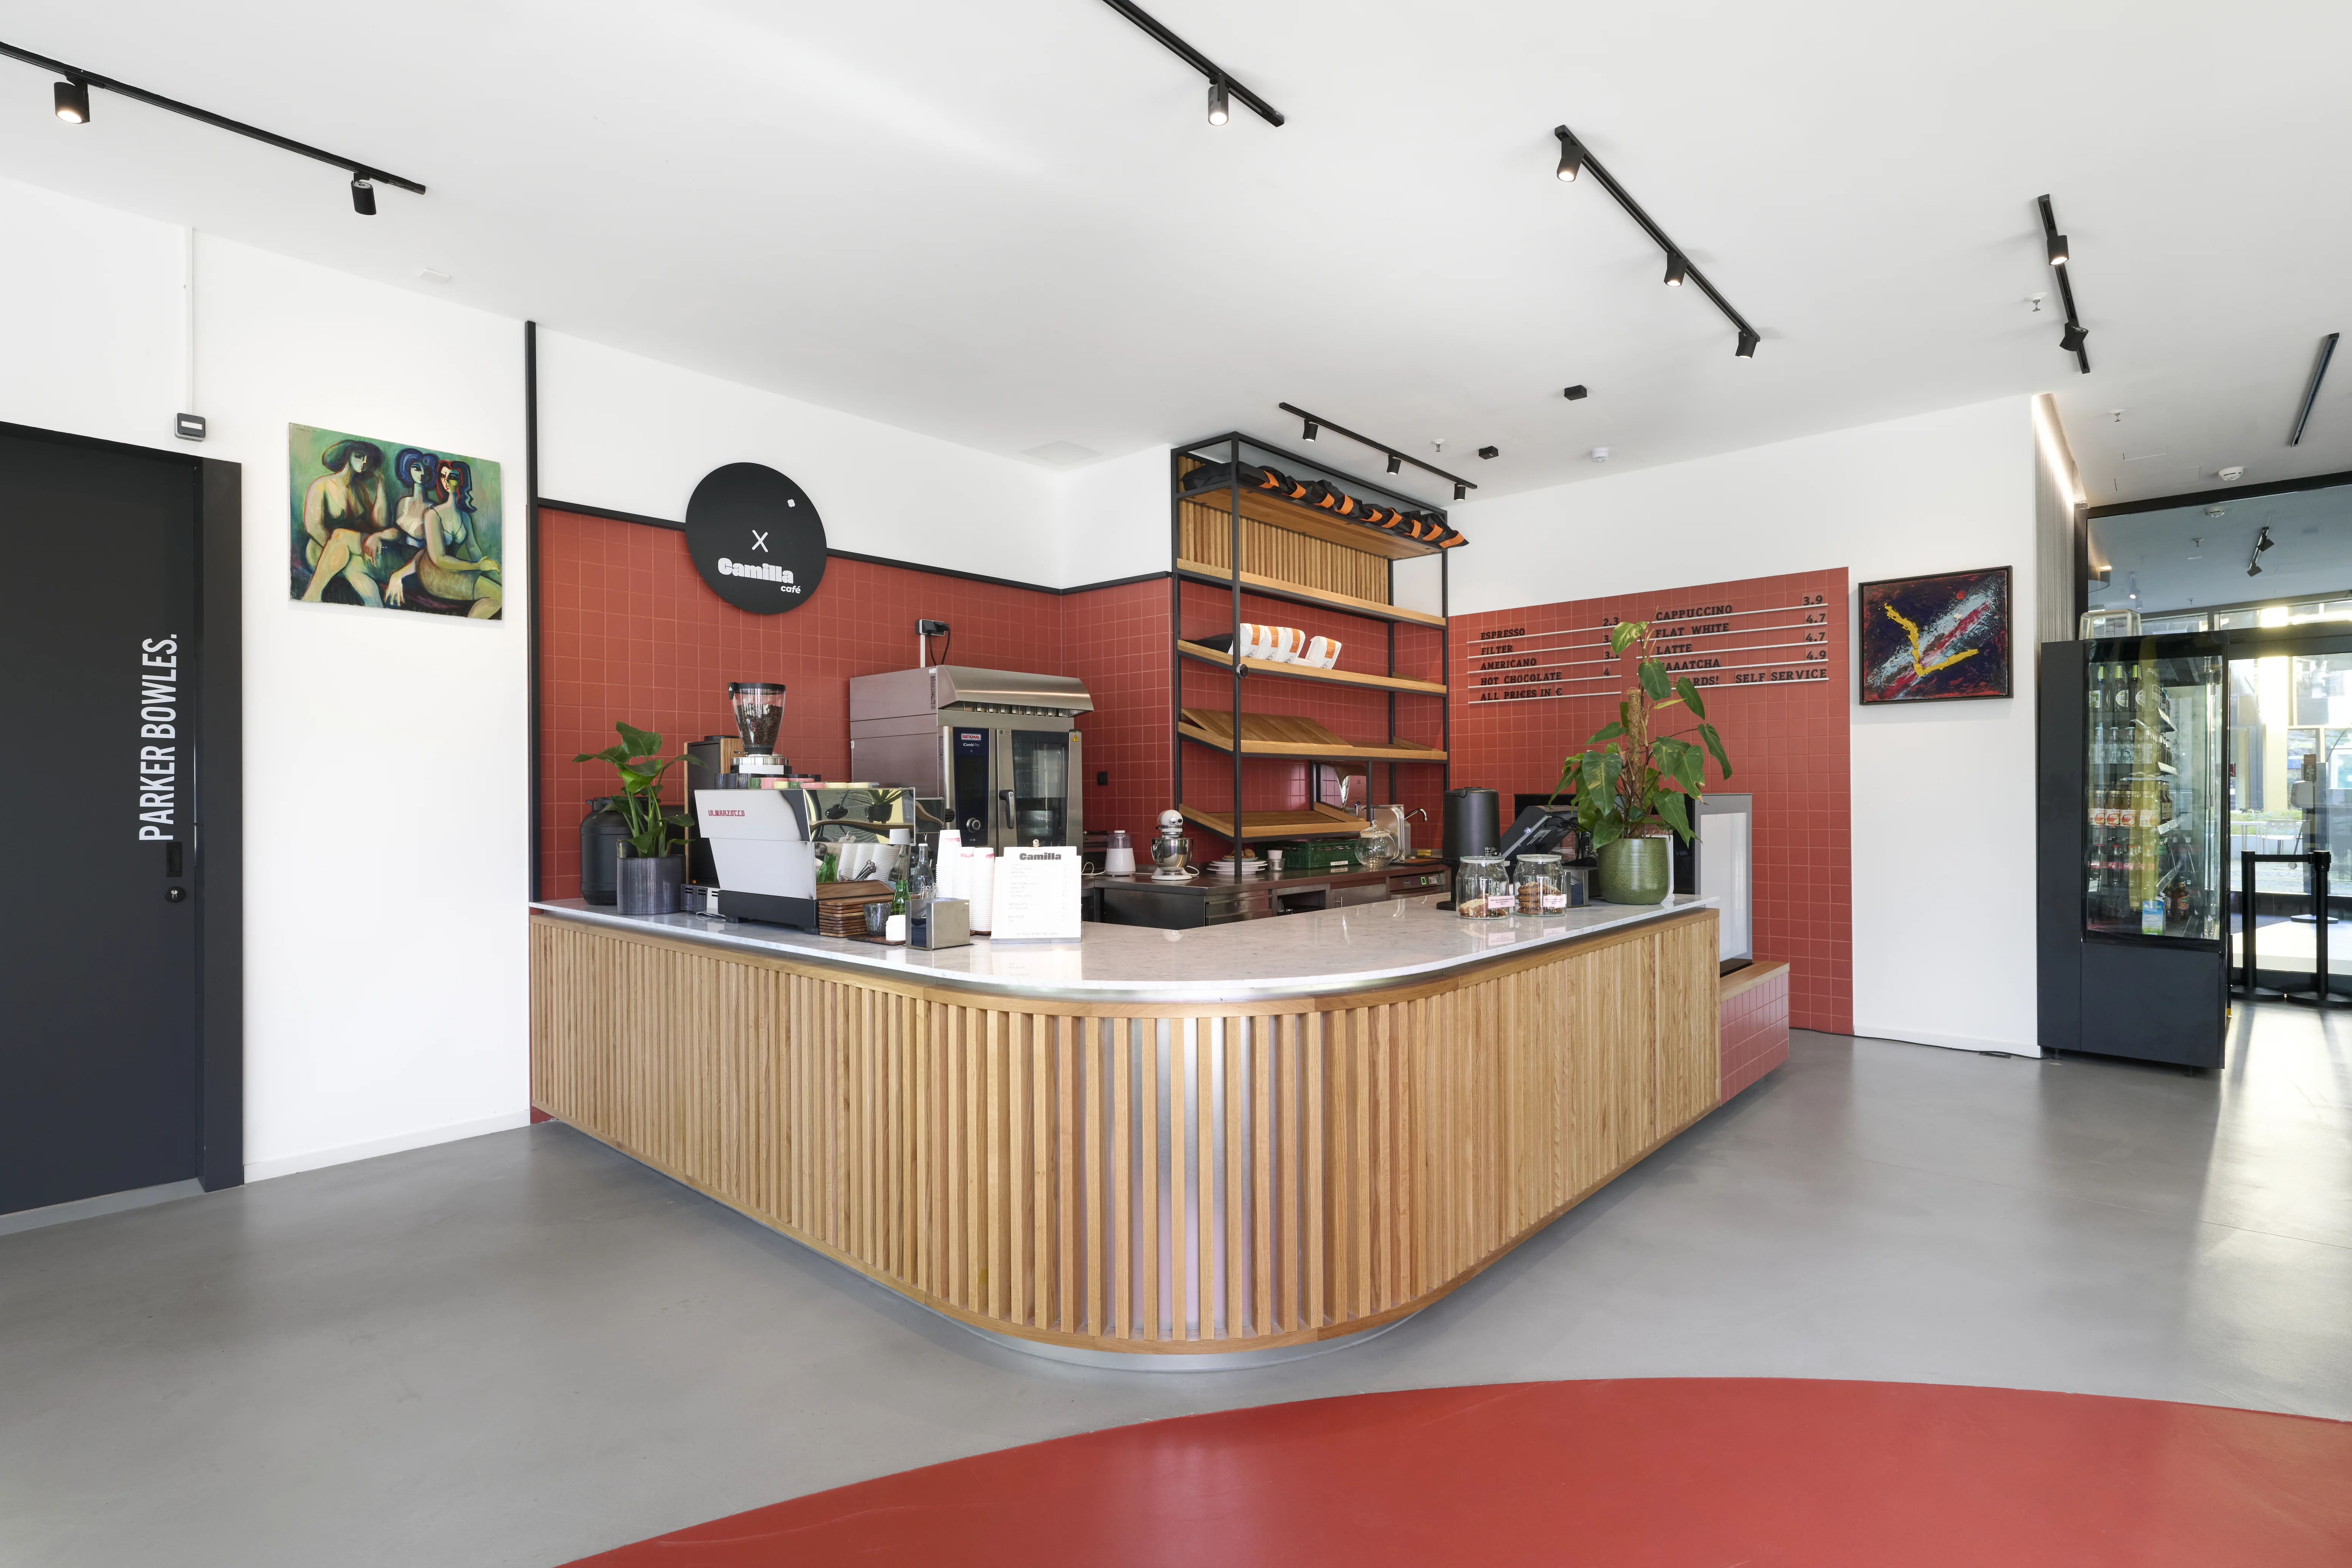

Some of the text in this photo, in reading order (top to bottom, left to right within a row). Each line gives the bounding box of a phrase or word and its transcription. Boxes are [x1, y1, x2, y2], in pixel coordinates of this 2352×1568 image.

[718, 558, 793, 584] Camilla
[781, 585, 801, 594] café
[1656, 595, 1823, 621] CAPPUCCINO 3.9
[1481, 617, 1618, 640] ESPRESSO 2.3
[1656, 613, 1826, 638] FLAT WHITE 4.7
[1481, 645, 1513, 655] FILTER
[1656, 632, 1825, 655] LATTE 4.7
[1480, 658, 1536, 670] AMERICANO
[1663, 650, 1826, 671] AAATCHA 4.9
[1480, 677, 1499, 685] HOT
[1504, 672, 1562, 684] CHOCOLATE
[1684, 676, 1719, 686] RDS!
[1736, 673, 1765, 683] SELF
[1771, 669, 1826, 681] SERVICE
[1480, 693, 1499, 701] ALL
[1540, 688, 1551, 697] IN
[139, 634, 177, 840] PARKER BOWLES.
[1020, 851, 1061, 860] Camilla
